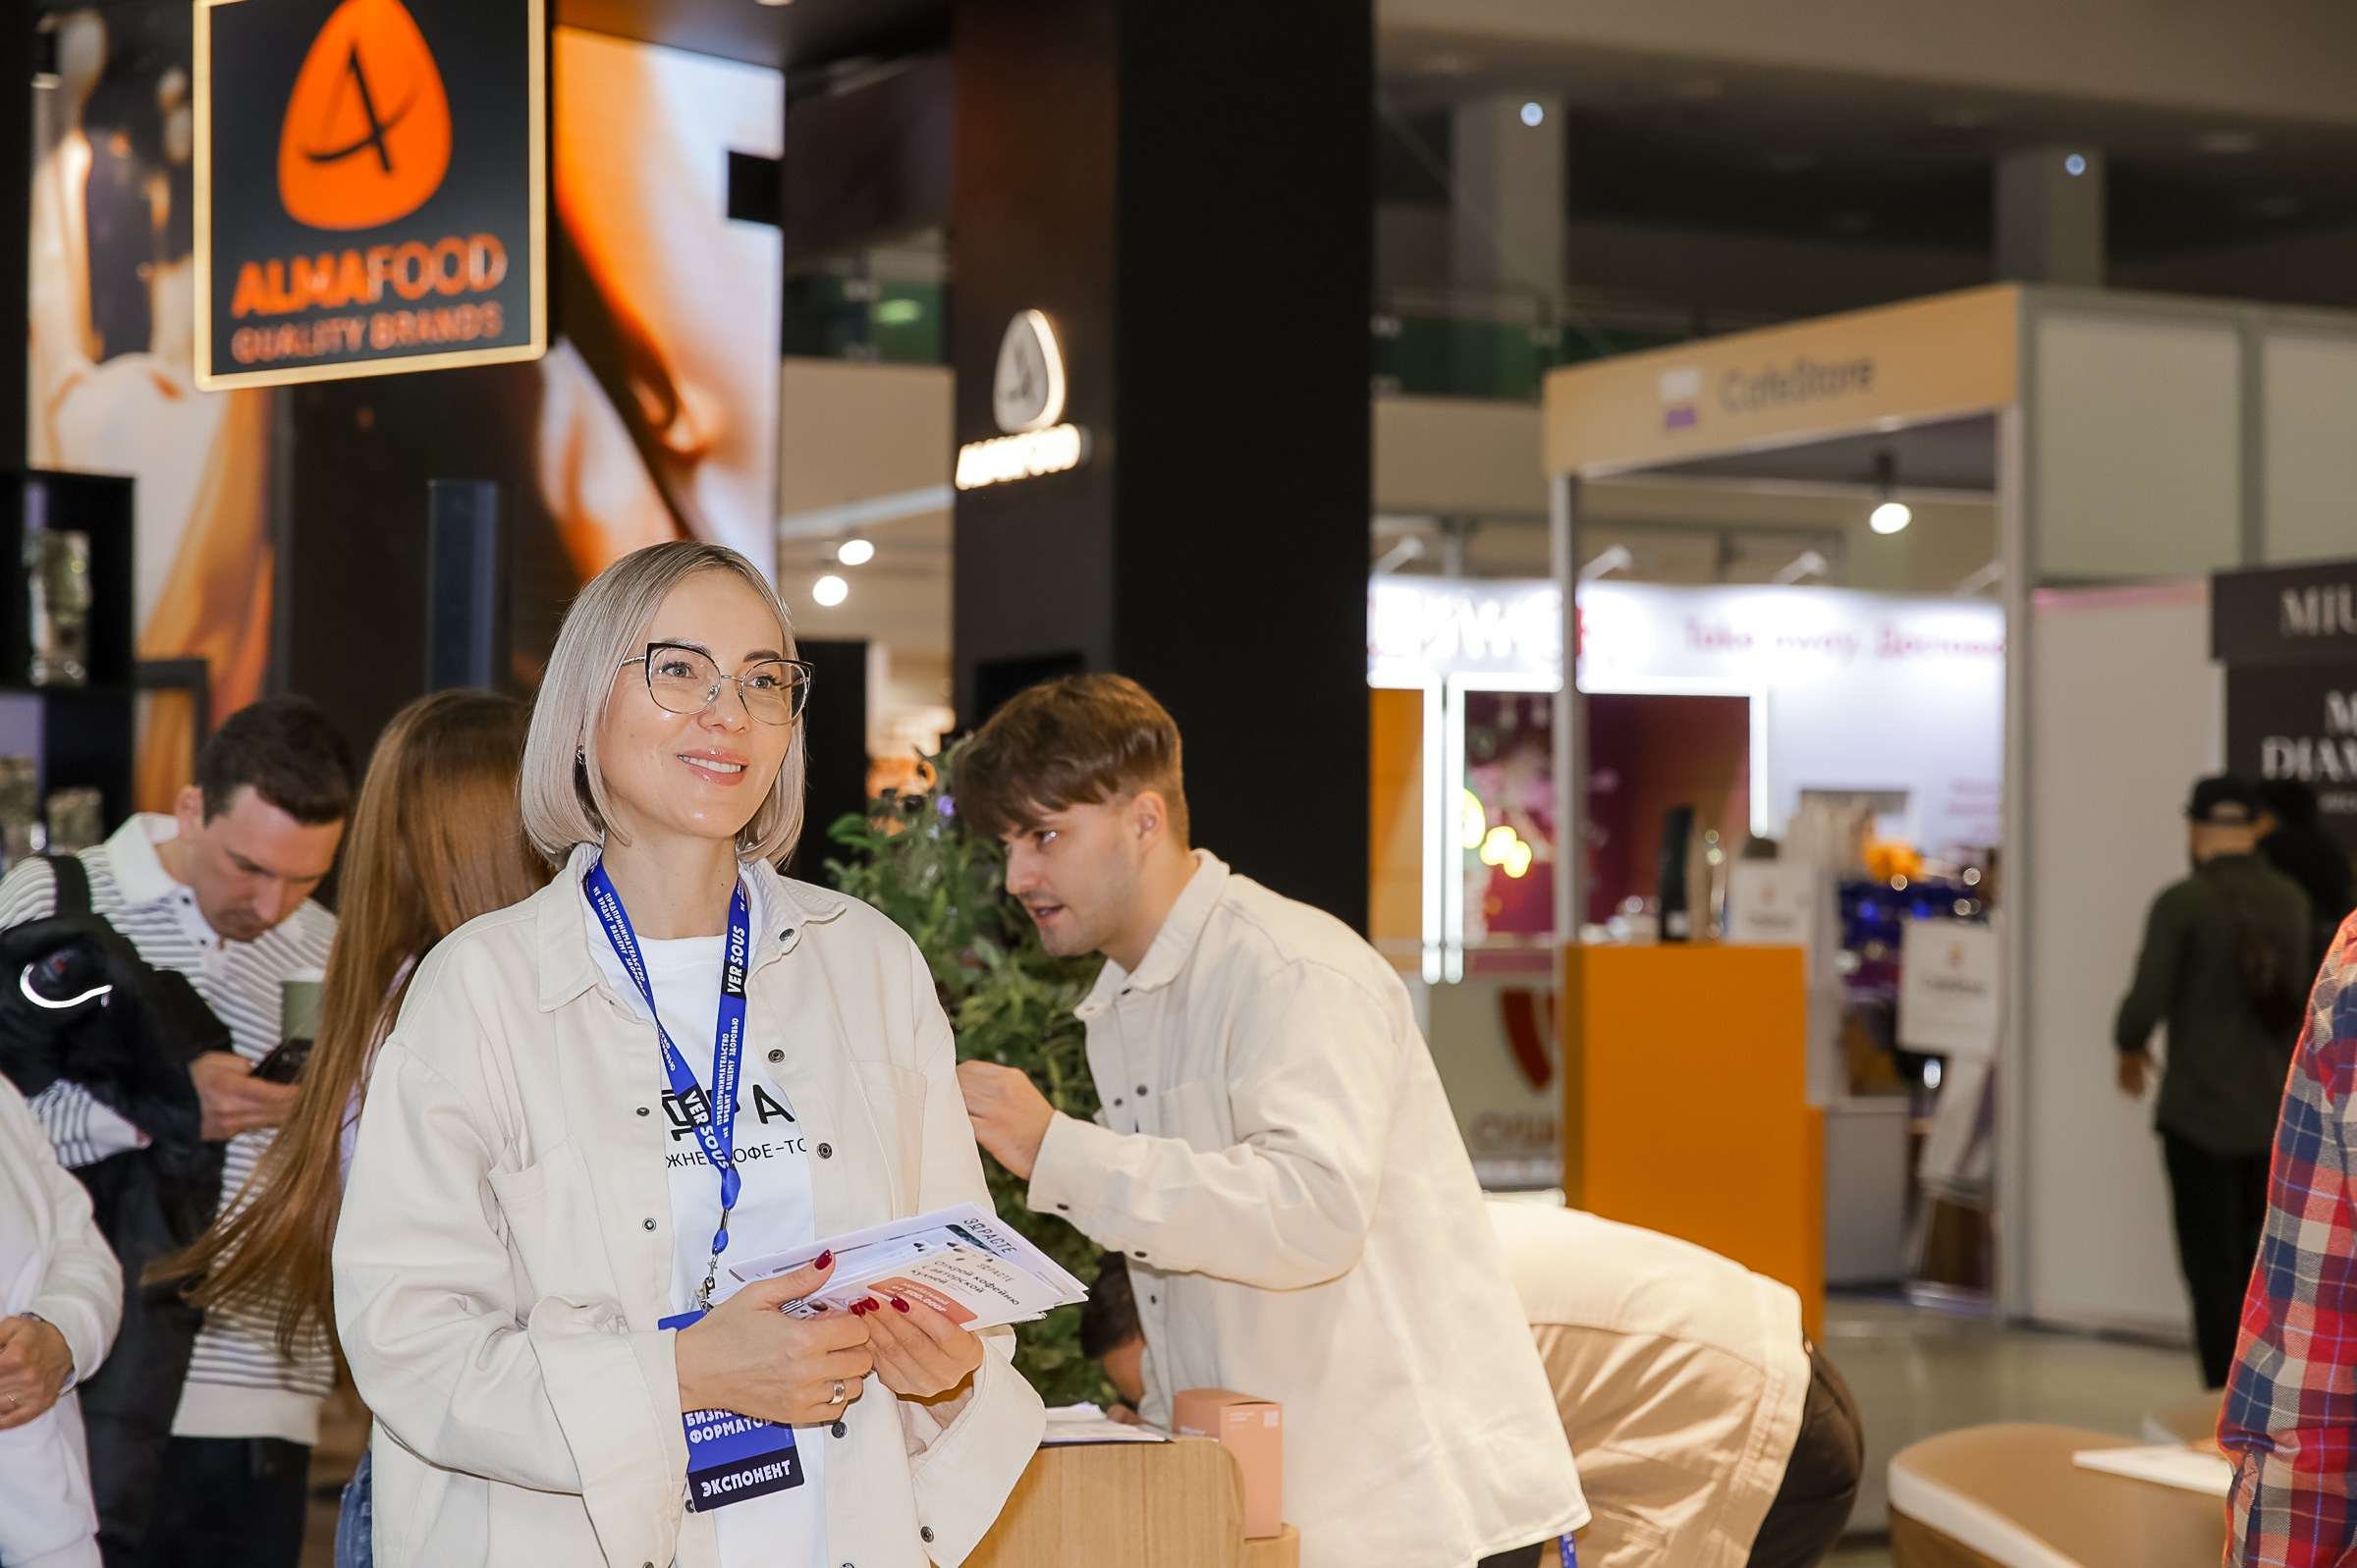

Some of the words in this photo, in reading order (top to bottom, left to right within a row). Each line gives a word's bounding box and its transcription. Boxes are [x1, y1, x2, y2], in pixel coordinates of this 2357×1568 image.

[231, 234, 508, 318] ALMAFOOD
[370, 300, 504, 351] BRANDS
[729, 1017, 740, 1056] ЗДОРОВЬЮ
[716, 1033, 730, 1126] ПРЕДПРИНИМАТЕЛЬСТВО
[725, 1059, 736, 1091] ВАШЕМУ
[723, 1094, 732, 1124] ВРЕДИТ
[963, 1217, 1017, 1254] ЗДРАСТЕ
[930, 1269, 986, 1294] авторской
[934, 1261, 973, 1278] Открой
[973, 1275, 1019, 1306] кофейню
[685, 1410, 733, 1428] БИЗНЕ
[700, 1459, 791, 1497] ЭКСПОНЕНТ
